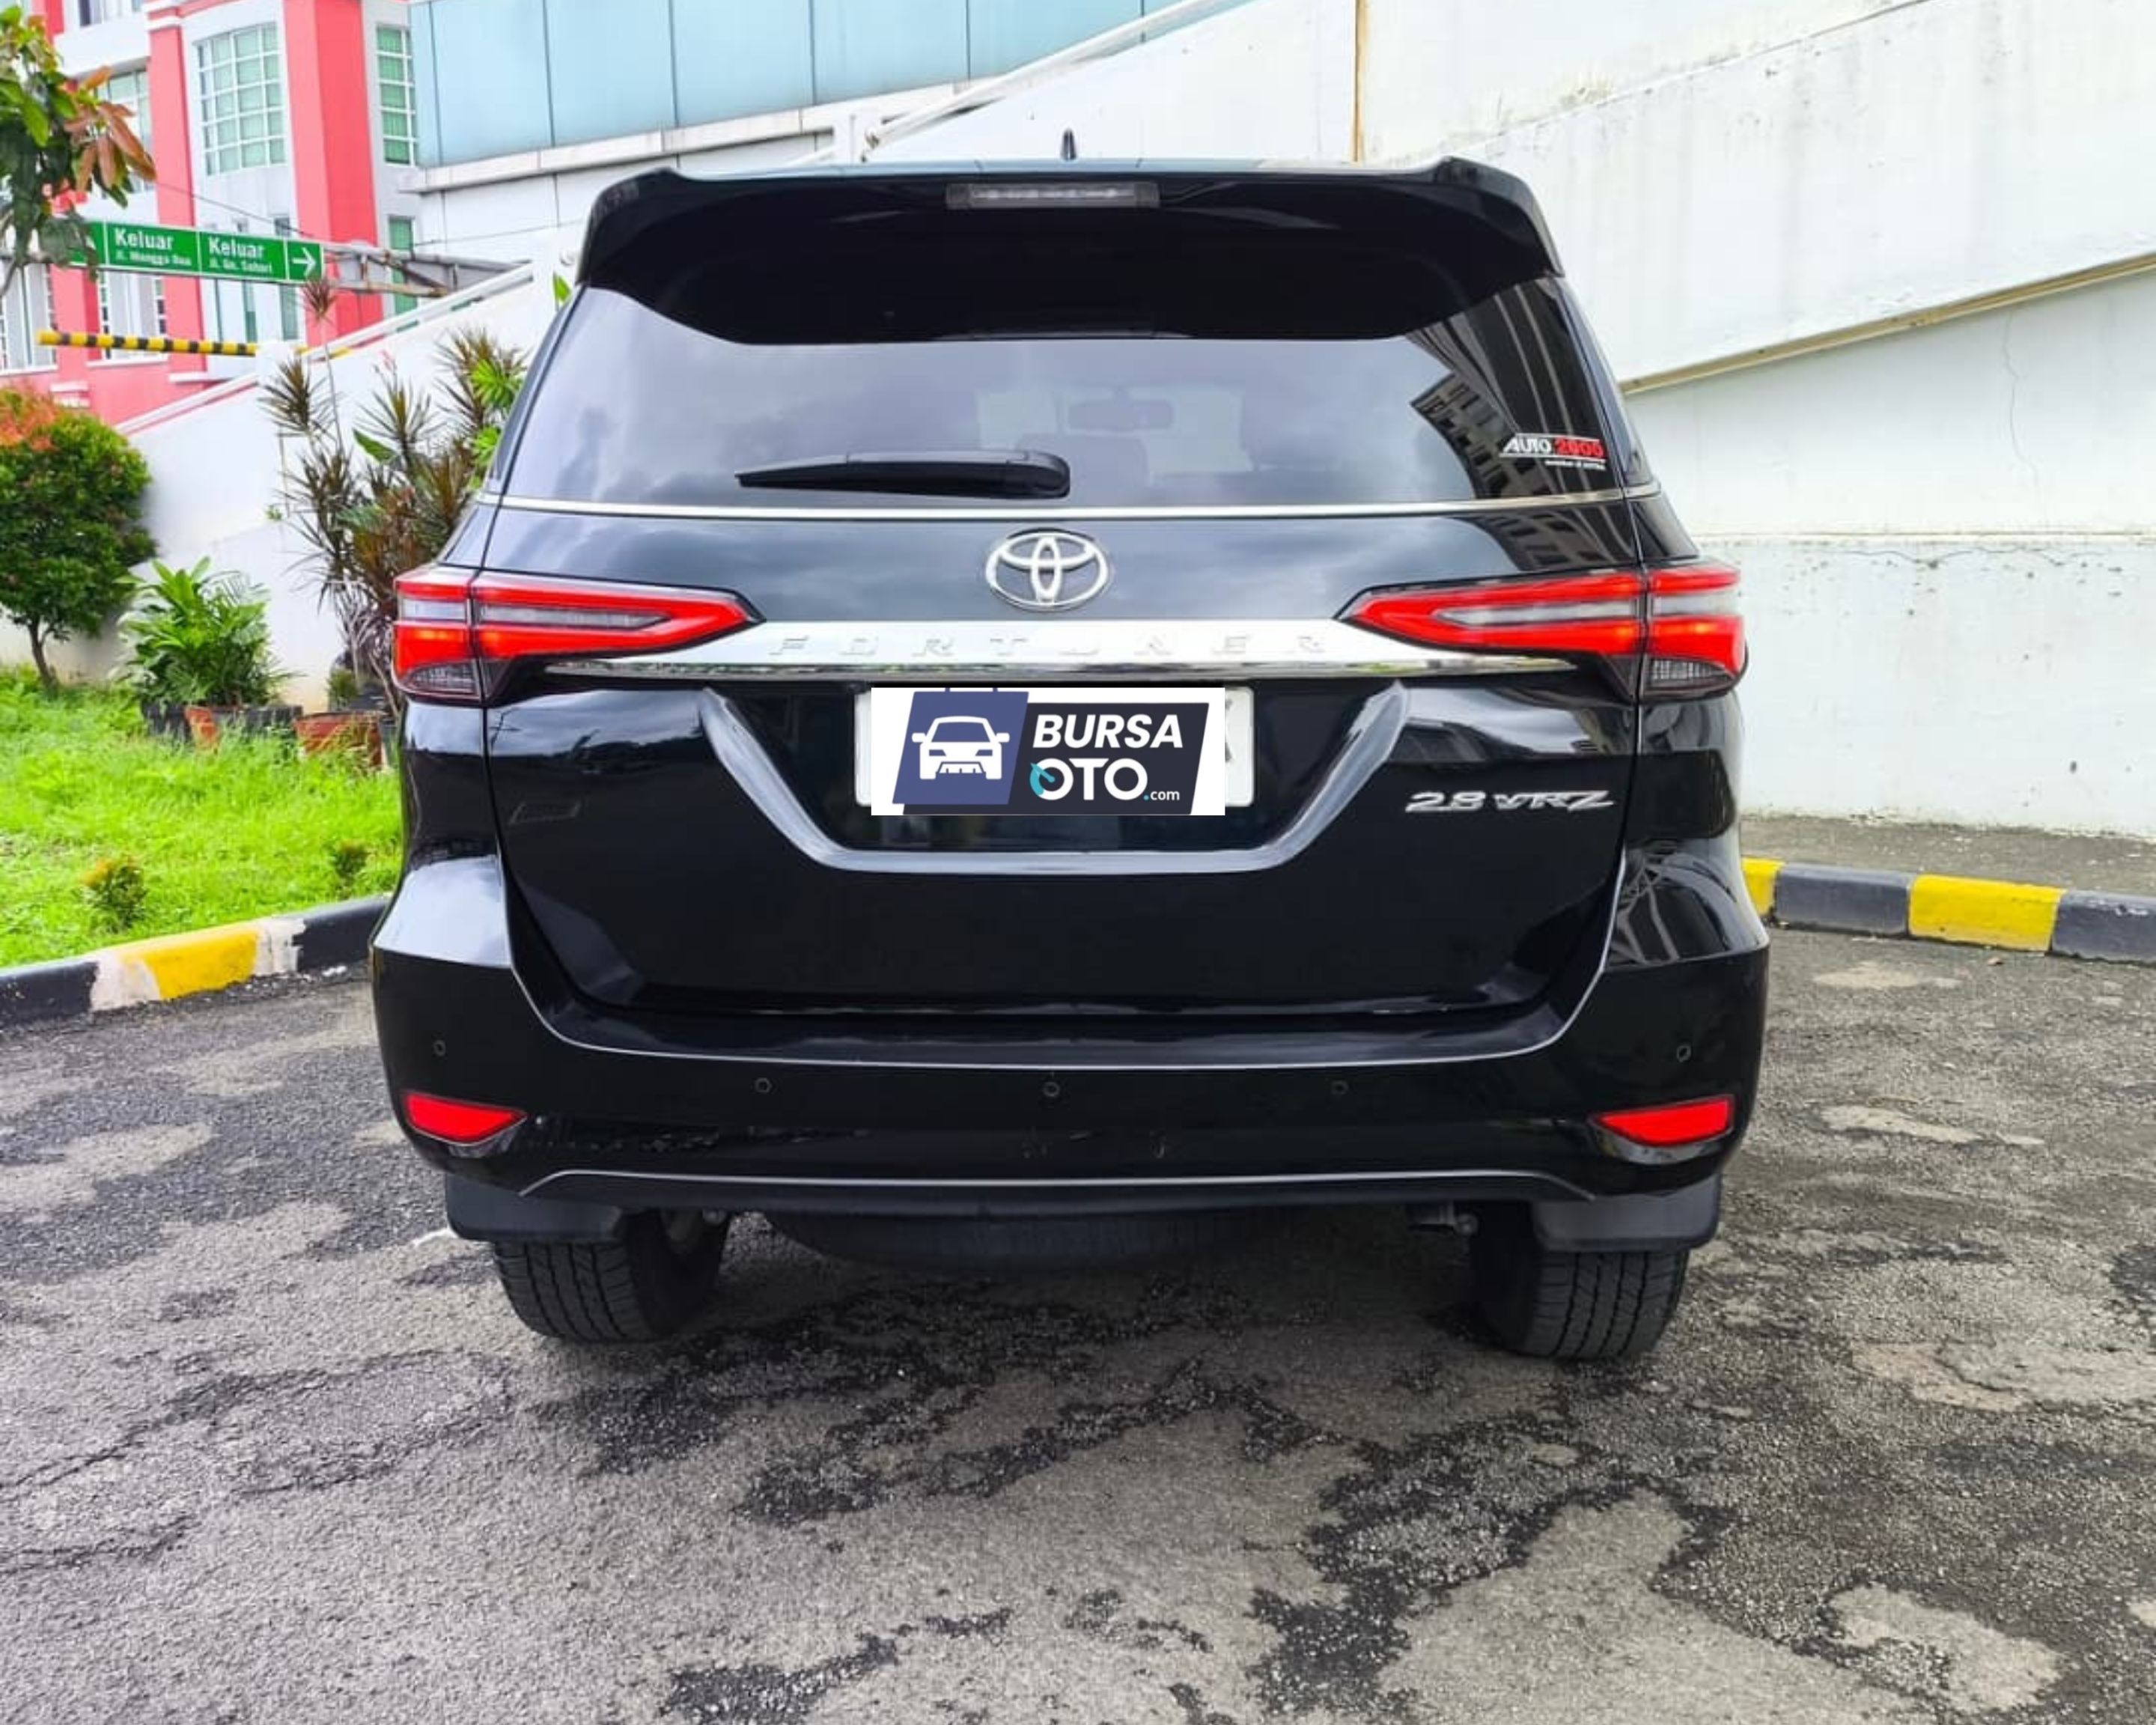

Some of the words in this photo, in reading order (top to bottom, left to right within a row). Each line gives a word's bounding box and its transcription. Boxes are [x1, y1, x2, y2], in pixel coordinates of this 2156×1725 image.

[115, 228, 174, 250] Keluar
[208, 236, 264, 259] Keluar
[1502, 436, 1552, 454] AUTO
[1553, 436, 1605, 458] 2000
[768, 635, 1327, 657] FORTUNER
[1493, 790, 1614, 812] VRZ
